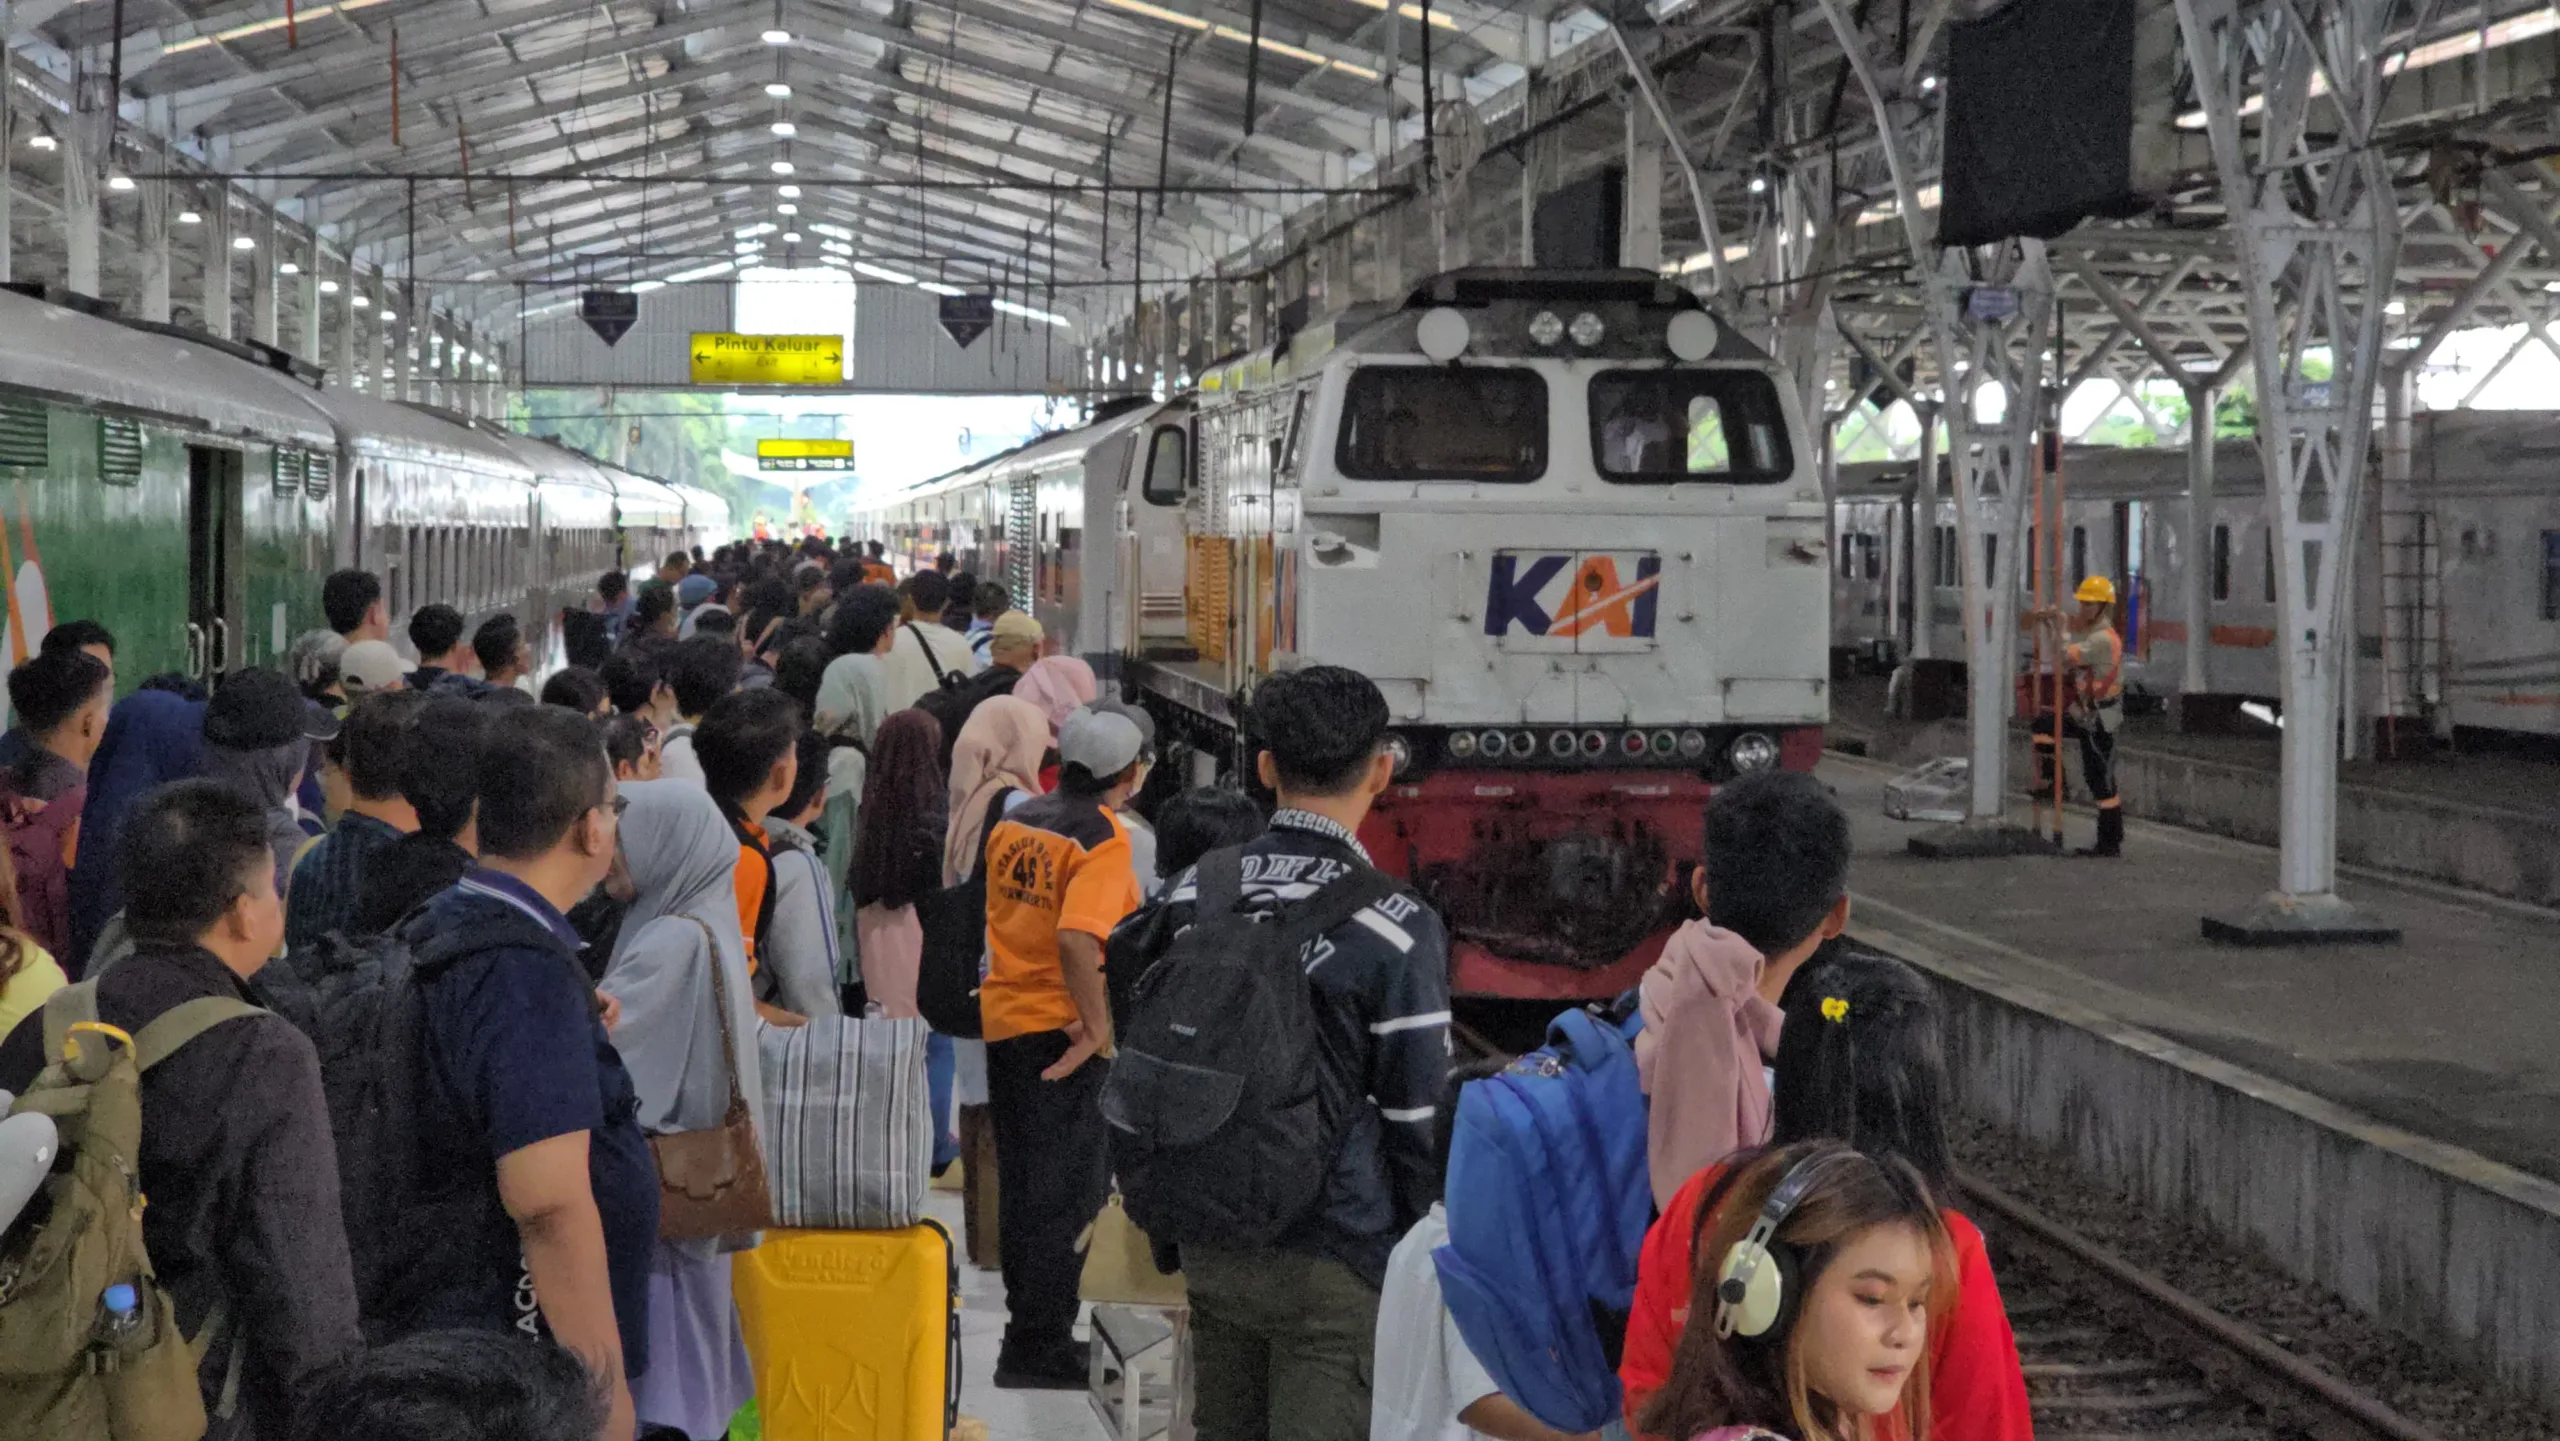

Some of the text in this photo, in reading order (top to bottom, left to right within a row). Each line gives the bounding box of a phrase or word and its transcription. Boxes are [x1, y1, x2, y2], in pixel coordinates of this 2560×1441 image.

[714, 336, 821, 352] Pintu Keluar
[1484, 555, 1663, 638] KAI
